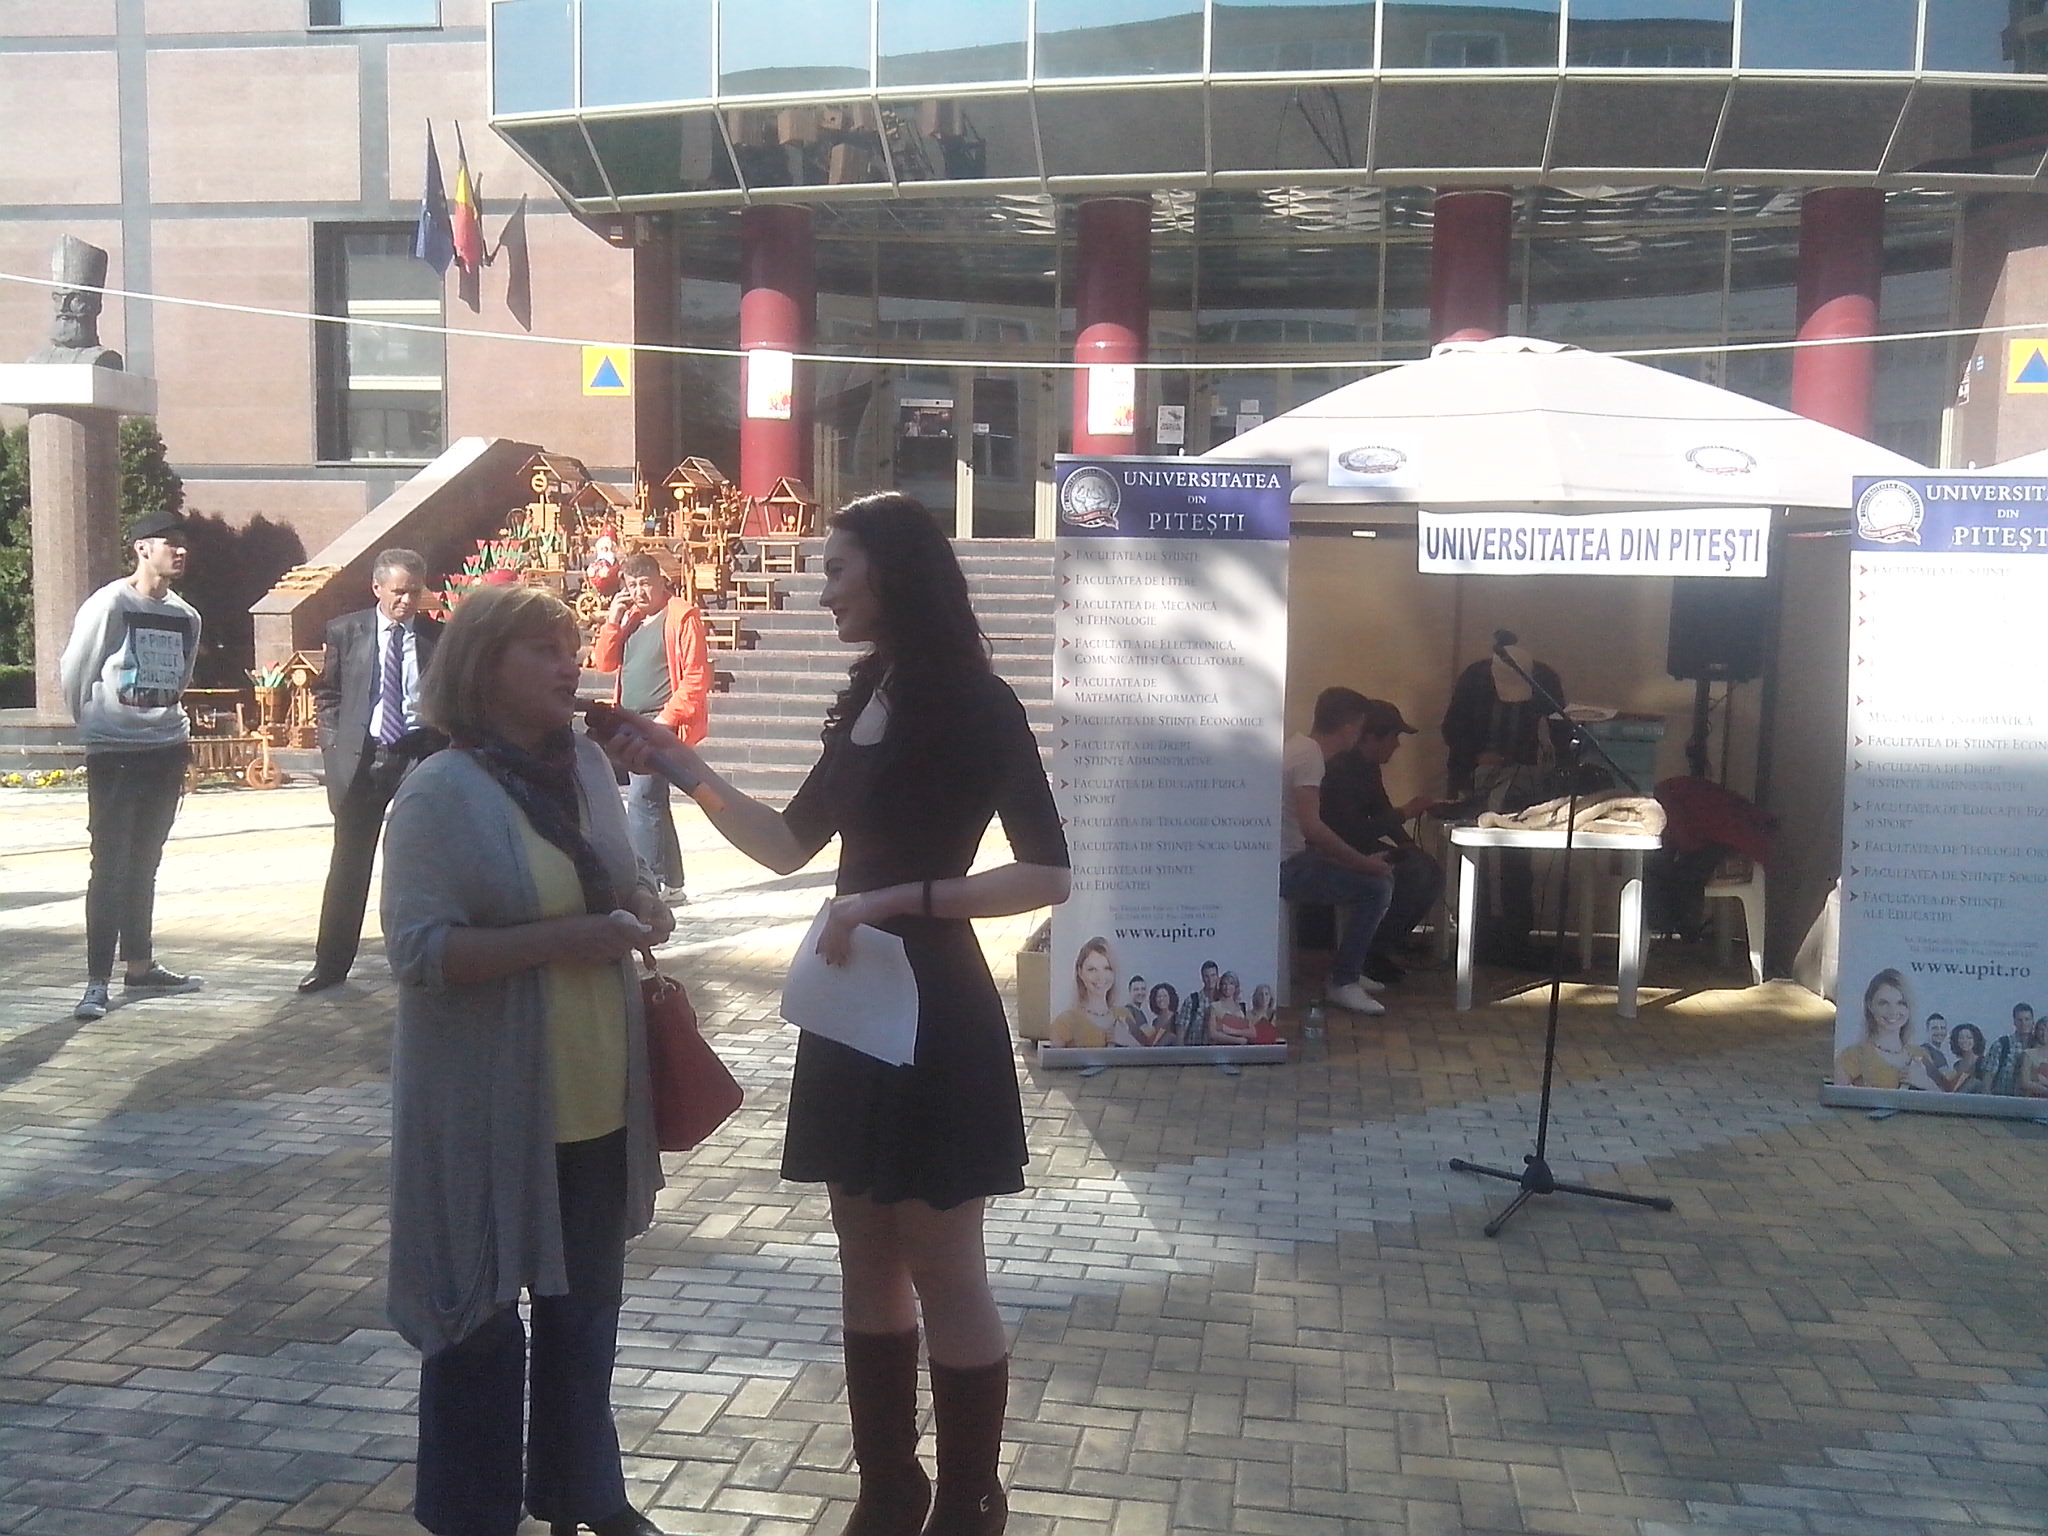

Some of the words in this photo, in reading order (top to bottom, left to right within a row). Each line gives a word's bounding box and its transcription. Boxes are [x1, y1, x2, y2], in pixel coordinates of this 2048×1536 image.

[1123, 471, 1281, 488] UNIVERSITATEA
[1926, 484, 2048, 501] UNIVERSIT
[1187, 495, 1207, 504] DIN
[1997, 509, 2020, 519] DIN
[1149, 512, 1245, 535] PITEȘTI
[1075, 549, 1142, 561] FACULTATEA
[1426, 527, 1610, 561] UNIVERSITATEA
[1619, 528, 1660, 561] DIN
[1669, 528, 1760, 571] PITEȘTI
[1075, 574, 1142, 585] FACULTATEA
[1144, 576, 1158, 586] DE
[1075, 599, 1142, 610] FACULTATEA
[1086, 615, 1157, 626] TEHNOLOGIE
[1075, 638, 1142, 649] FACULTATEA
[1143, 639, 1158, 649] DE
[1161, 655, 1245, 667] CALCULATOARE
[1075, 676, 1141, 688] FACULTATEA
[1143, 678, 1157, 688] DE
[1075, 715, 1138, 727] FACULTATEA
[1199, 716, 1264, 727] ECONOMICE
[1074, 739, 1138, 751] FACULTATEA
[1868, 735, 1942, 748] FACULTATEA
[1945, 738, 1960, 749] DE
[1867, 760, 1941, 774] FACULTATEA
[1073, 778, 1139, 789] FACULTATEA
[1084, 794, 1116, 805] SPORT
[1866, 801, 1941, 815] FACULTATEA
[1073, 816, 1139, 828] FACULTATEA
[1158, 816, 1209, 828] TEOLOGIE
[1073, 840, 1138, 852] FACULTATEA
[1865, 841, 1939, 855] FACULTATEA
[1942, 844, 1958, 856] DE
[1073, 864, 1138, 876] FACULTATEA
[1864, 866, 1939, 880] FACULTATEA
[1941, 869, 1958, 881] DE
[1072, 880, 1091, 891] ALE
[1863, 891, 1938, 905] FACULTATEA
[1862, 909, 1884, 920] ALE
[1115, 923, 1216, 943] www.upit.ro
[1911, 960, 2031, 980] www.upit.ro
